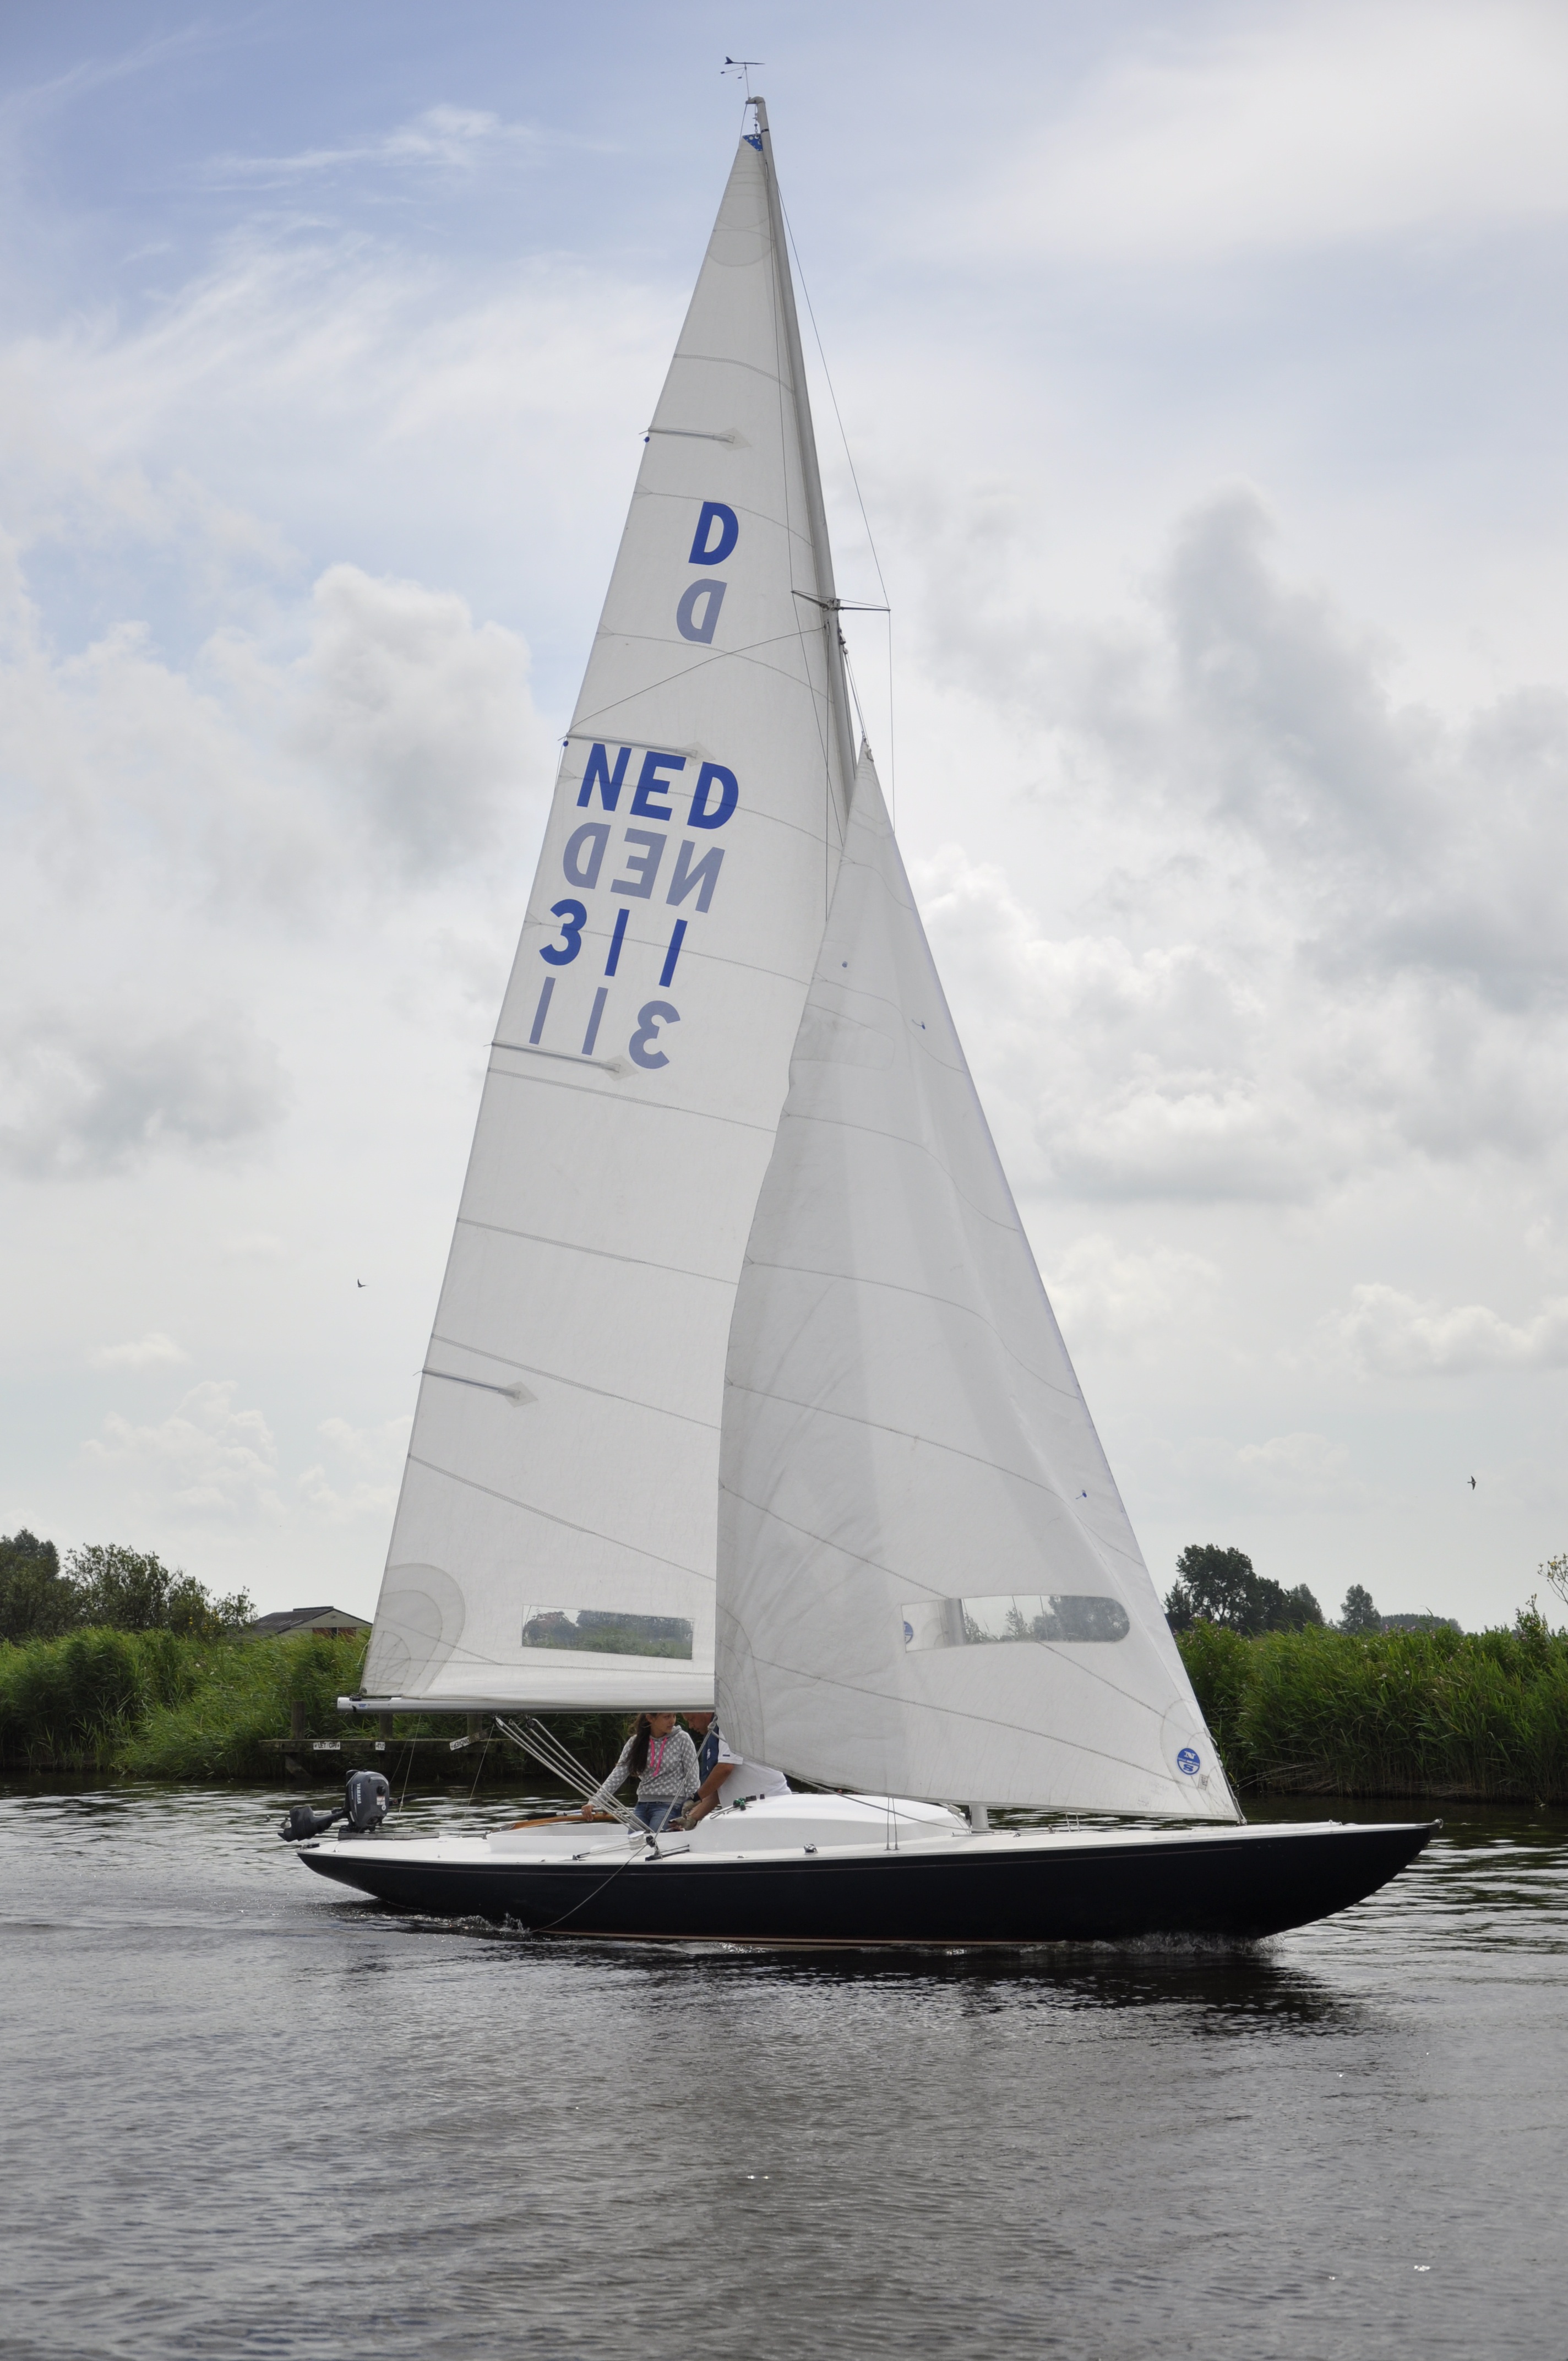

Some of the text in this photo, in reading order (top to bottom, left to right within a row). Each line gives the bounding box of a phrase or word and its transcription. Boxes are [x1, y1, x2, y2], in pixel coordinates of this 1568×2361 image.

[688, 502, 739, 566] D
[576, 743, 739, 830] NED
[539, 899, 688, 987] 311
[1184, 1751, 1196, 1759] N
